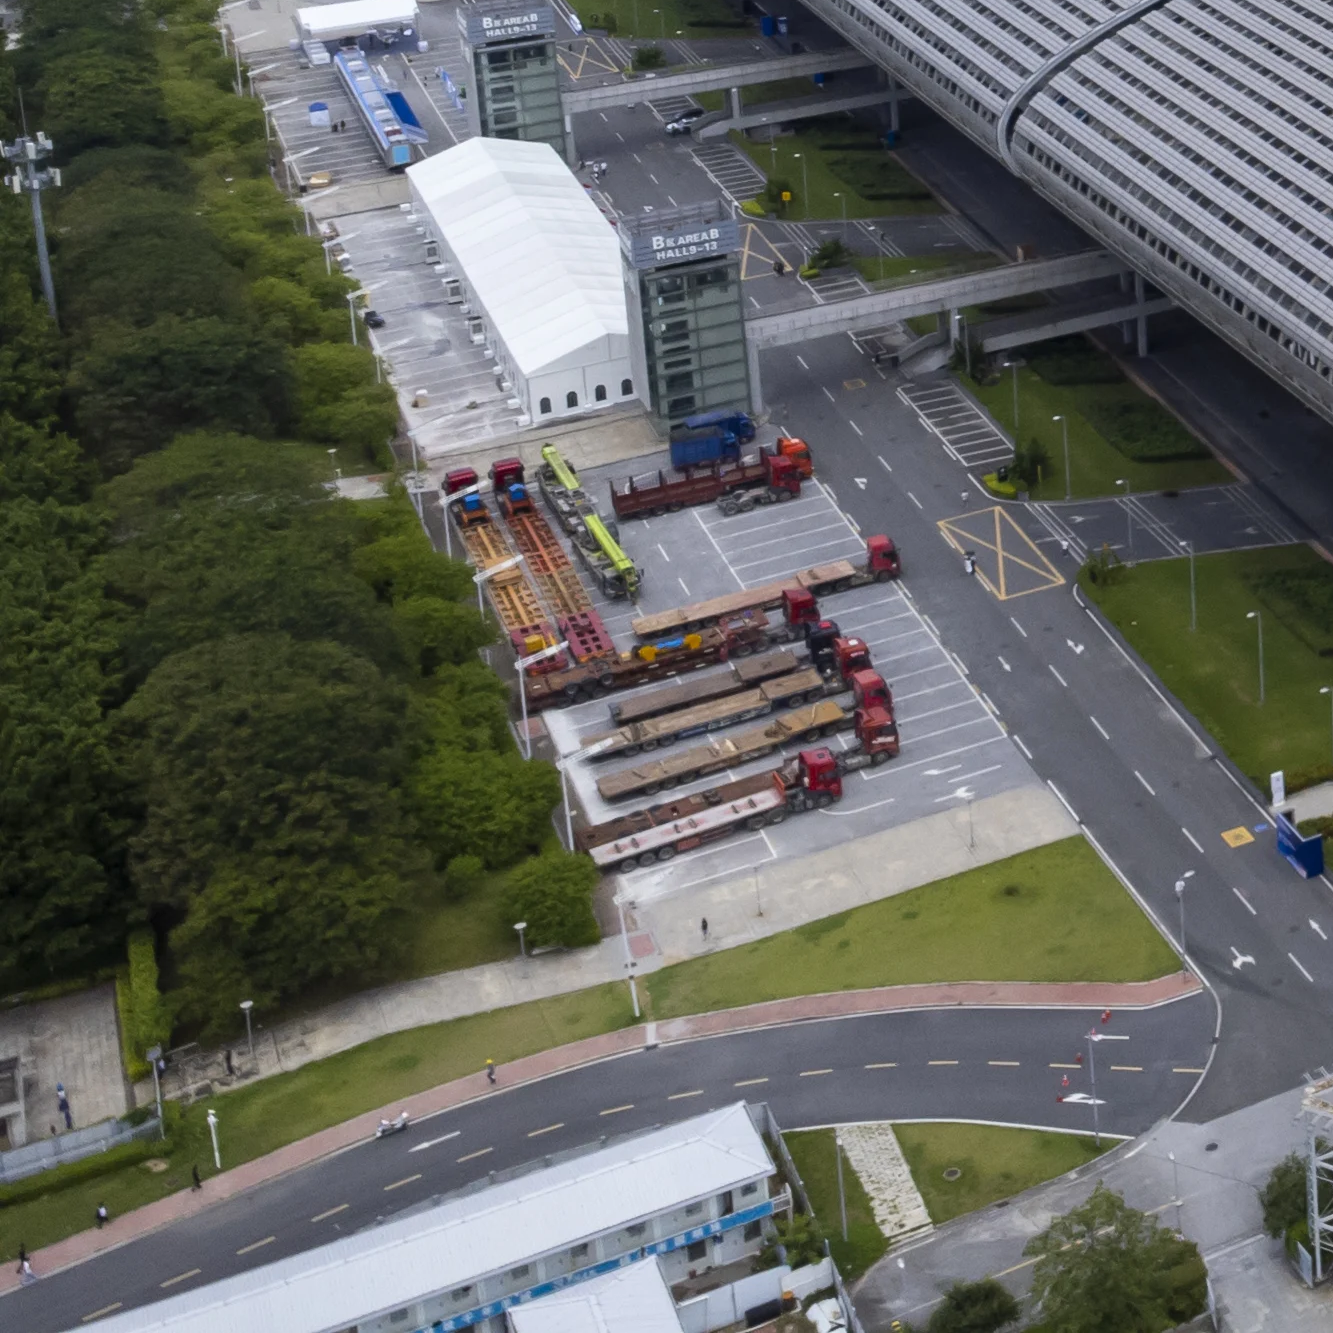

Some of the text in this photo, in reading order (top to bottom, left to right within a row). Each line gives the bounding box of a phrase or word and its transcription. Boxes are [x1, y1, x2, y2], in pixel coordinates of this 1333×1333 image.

[530, 13, 539, 22] B
[677, 232, 709, 245] AREA
[710, 228, 720, 239] B
[656, 242, 718, 260] HALL 9-13
